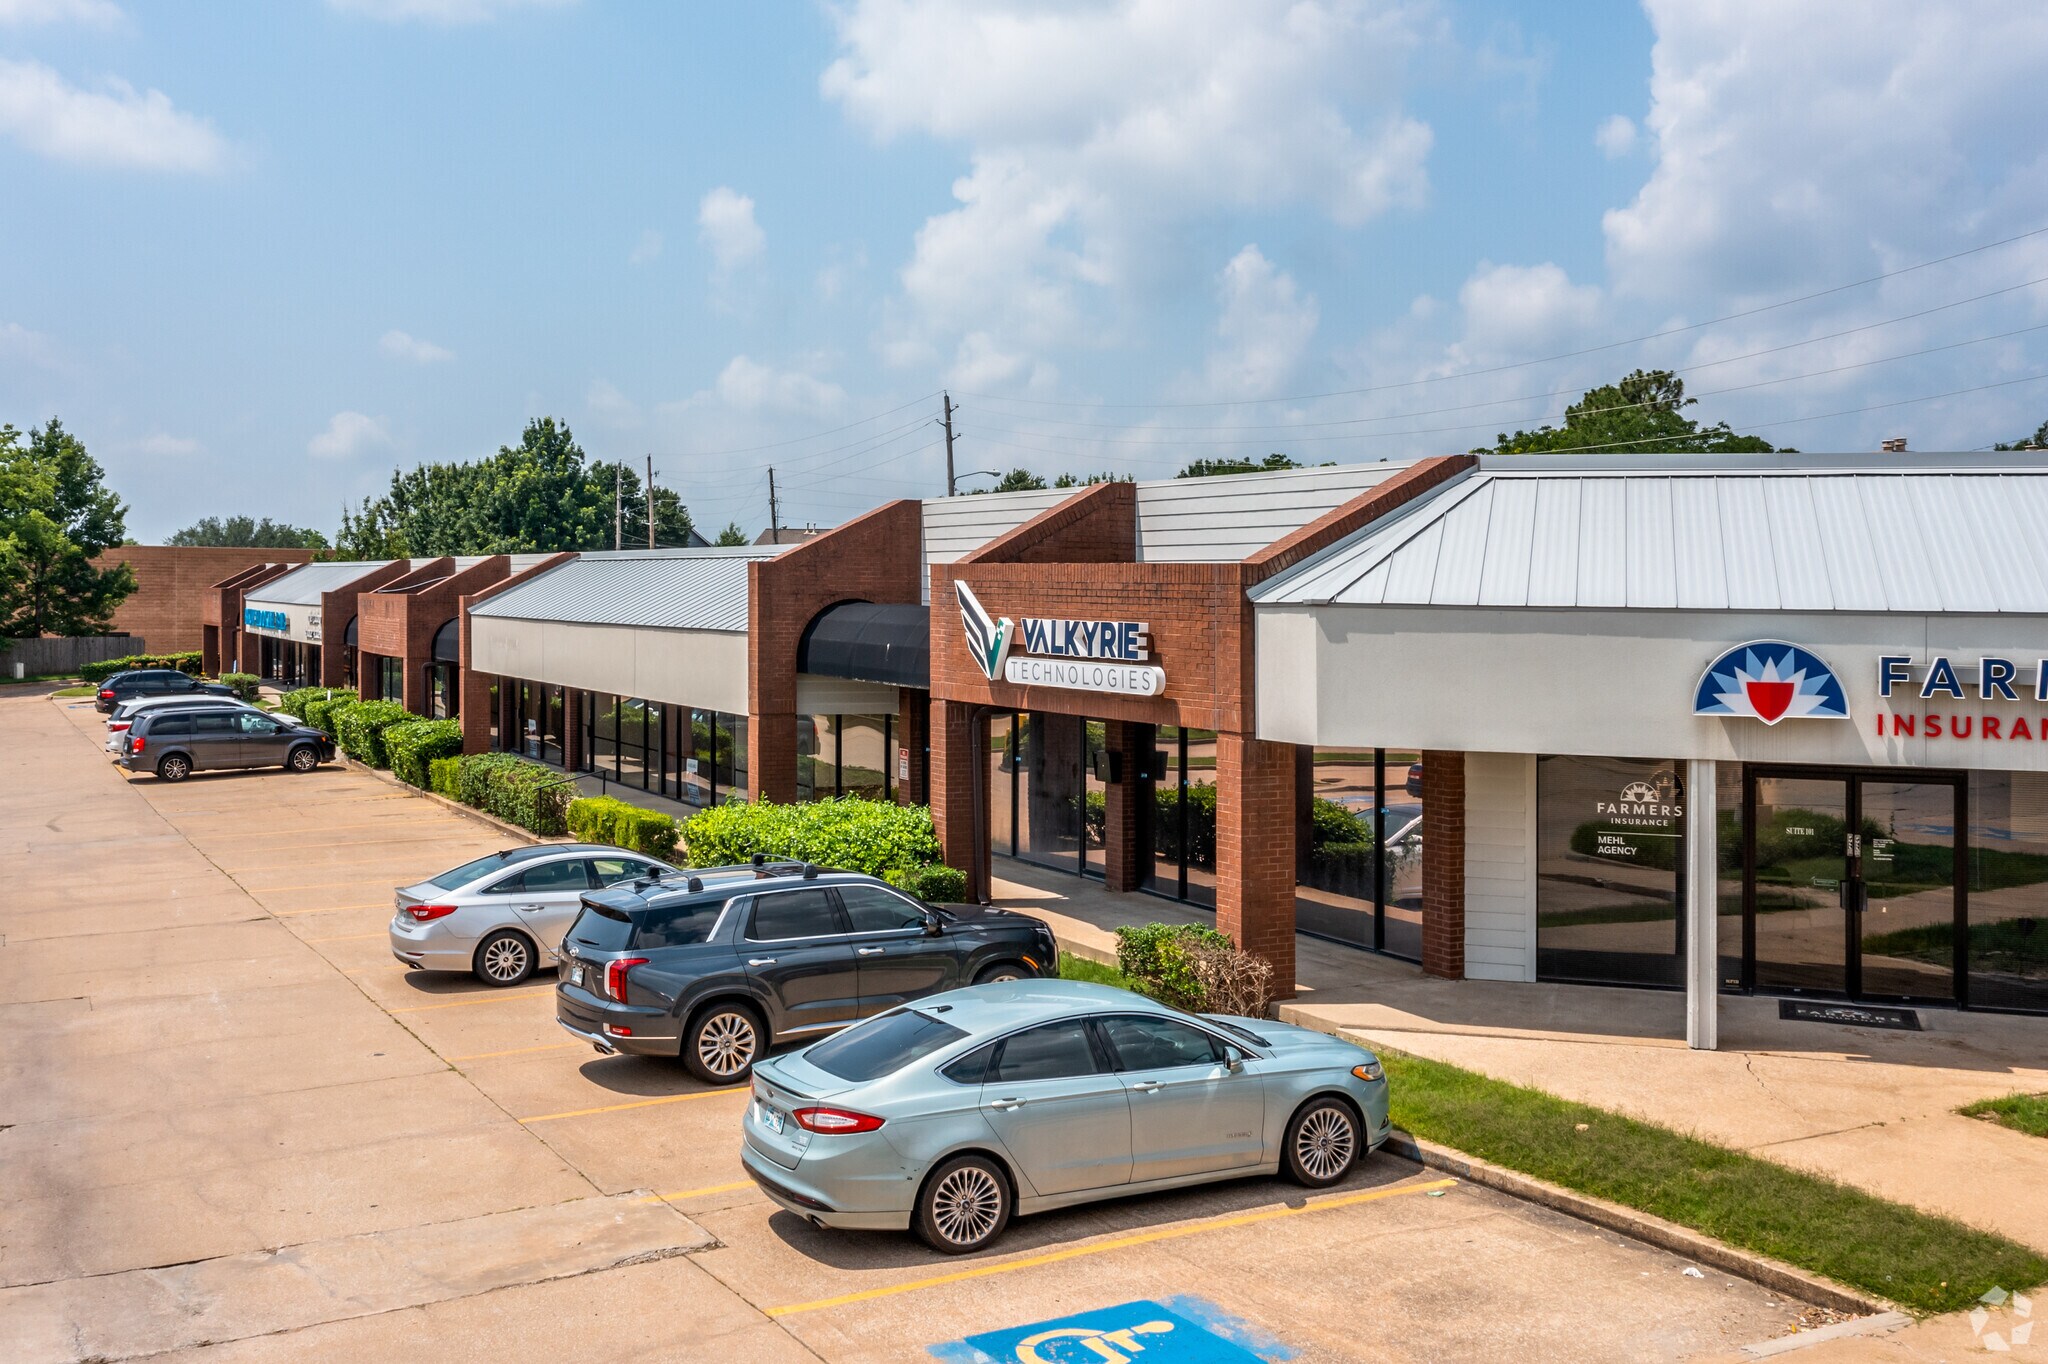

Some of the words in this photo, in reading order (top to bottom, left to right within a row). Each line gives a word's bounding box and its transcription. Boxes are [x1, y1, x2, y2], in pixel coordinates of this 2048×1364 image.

[1021, 618, 1149, 660] VALKYRIE
[1010, 661, 1151, 691] TECHNOLOGIES
[1878, 655, 2048, 701] FAR
[1597, 803, 1682, 816] FARMERS
[1611, 818, 1668, 826] INSURANCE
[1786, 827, 1805, 835] SUITE
[1597, 836, 1626, 845] MEHL
[1597, 846, 1637, 855] AGENCY
